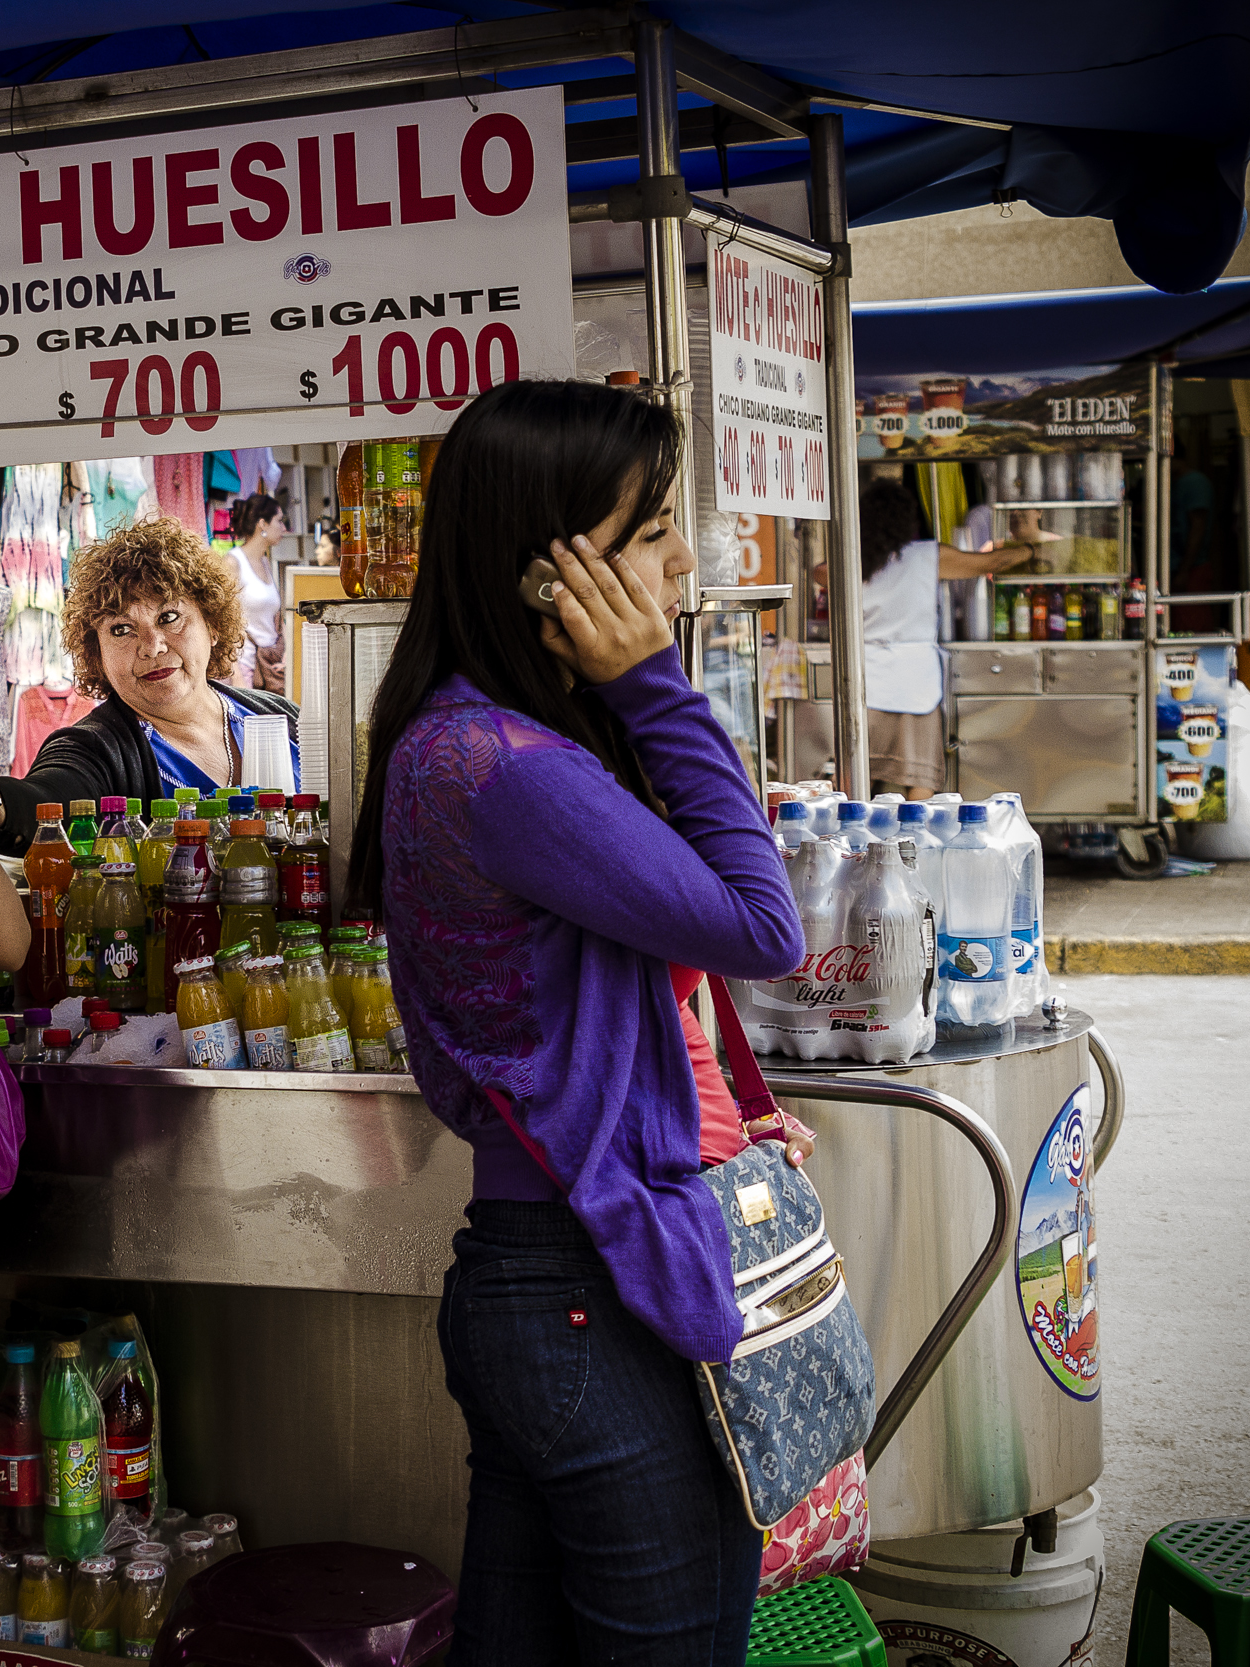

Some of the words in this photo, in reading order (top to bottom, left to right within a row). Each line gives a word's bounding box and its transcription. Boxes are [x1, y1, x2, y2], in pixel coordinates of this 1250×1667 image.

[19, 112, 535, 265] HUESILLO
[36, 311, 251, 353] GRANDE
[269, 285, 521, 332] GIGANTE
[714, 248, 751, 342] MOTE
[766, 268, 822, 364] HUESILLO
[58, 390, 76, 420] $
[89, 350, 222, 439] 700
[299, 369, 319, 402] $
[332, 321, 520, 418] 1000
[754, 358, 787, 393] TRADICIONAL
[718, 392, 740, 417] CHICO
[741, 397, 770, 424] MEDIANO
[771, 404, 797, 429] GRANDE
[797, 410, 824, 434] GIGANTE
[1047, 424, 1075, 437] Mote
[1076, 425, 1095, 435] con
[1097, 423, 1137, 436] Huesillo
[723, 425, 741, 497] 400
[750, 430, 767, 499] 600
[778, 435, 795, 501] 700
[804, 437, 825, 503] 1000
[794, 983, 848, 1009] light
